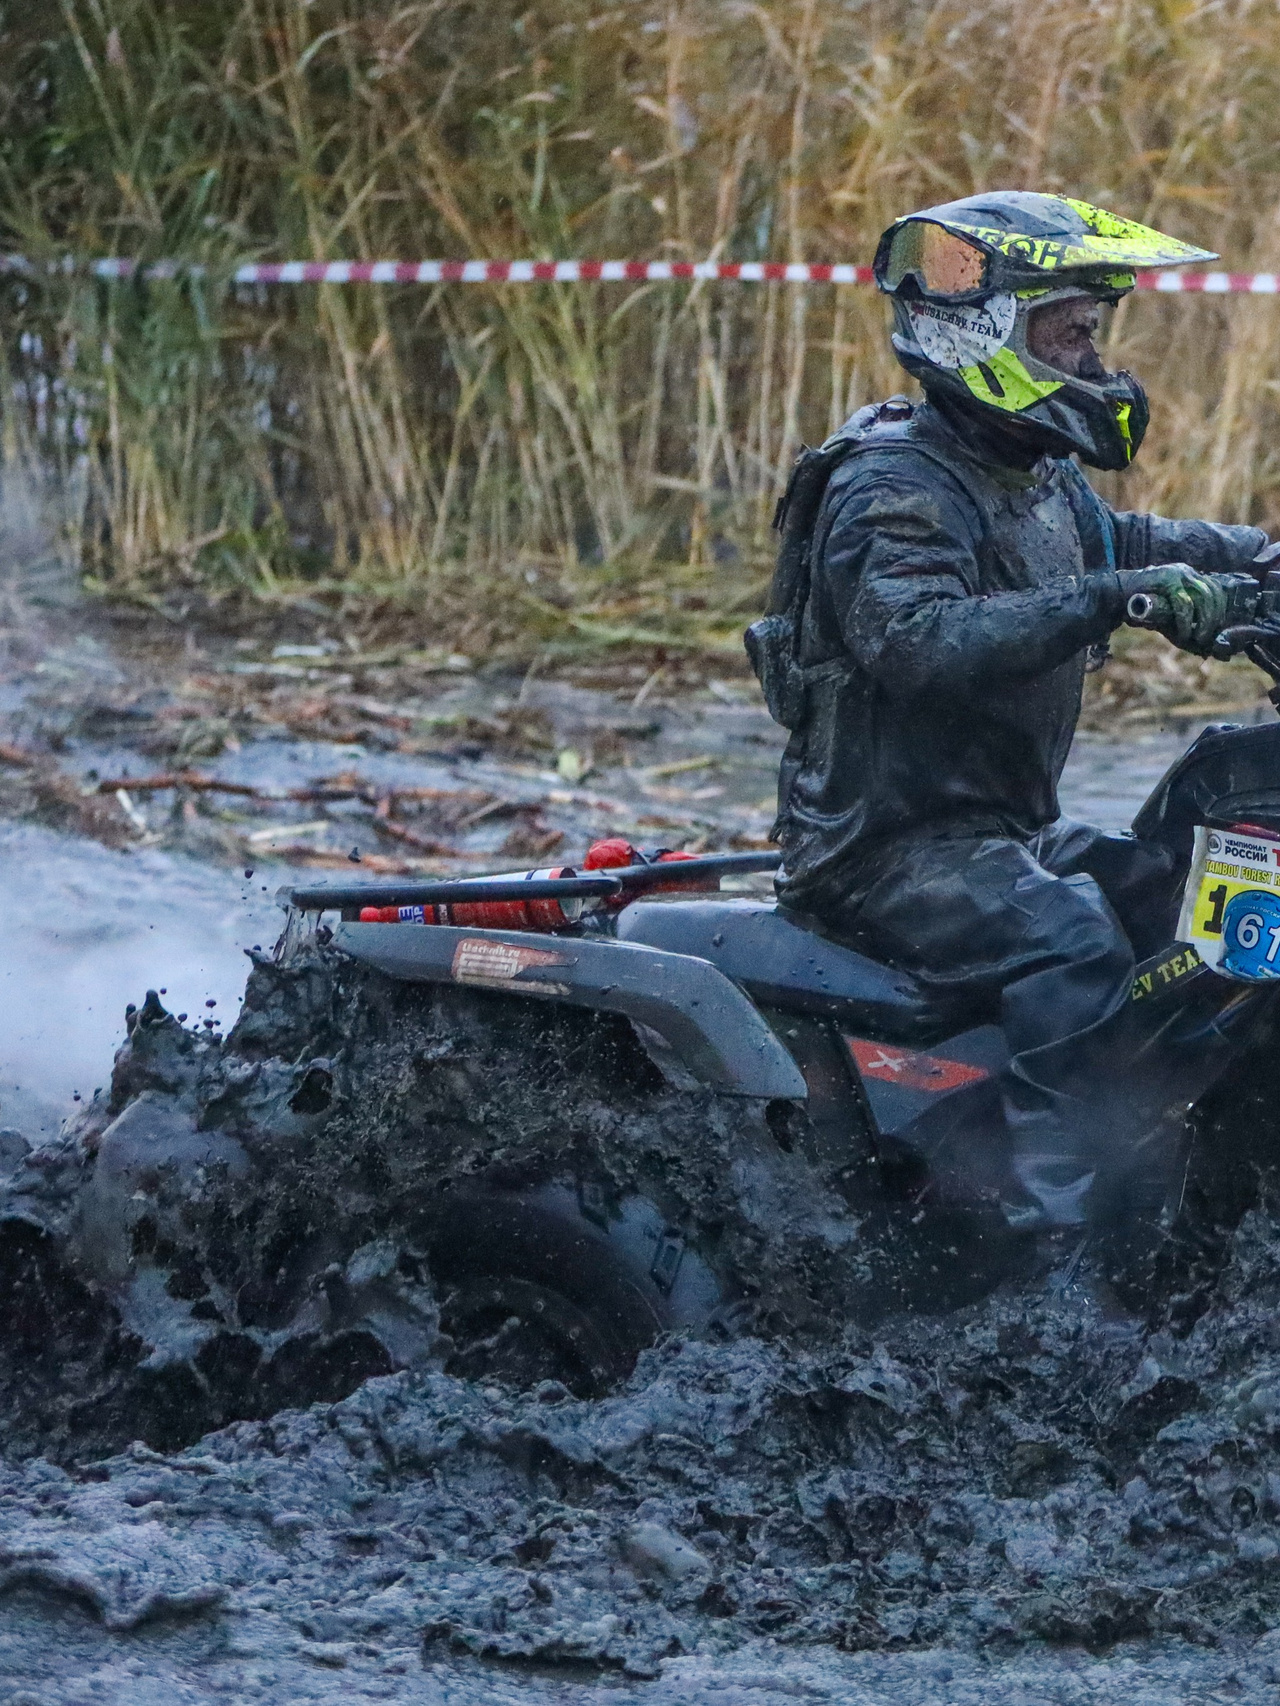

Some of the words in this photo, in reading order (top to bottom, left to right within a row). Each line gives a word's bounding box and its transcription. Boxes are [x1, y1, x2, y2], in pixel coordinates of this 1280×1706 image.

[971, 321, 1003, 339] TEAM
[1225, 838, 1267, 852] ЧЕМПИОНАТ
[1225, 846, 1268, 863] РОССИИ
[1205, 860, 1239, 878] TAMBOV
[1241, 866, 1273, 884] FOREST
[1157, 949, 1204, 983] TEA
